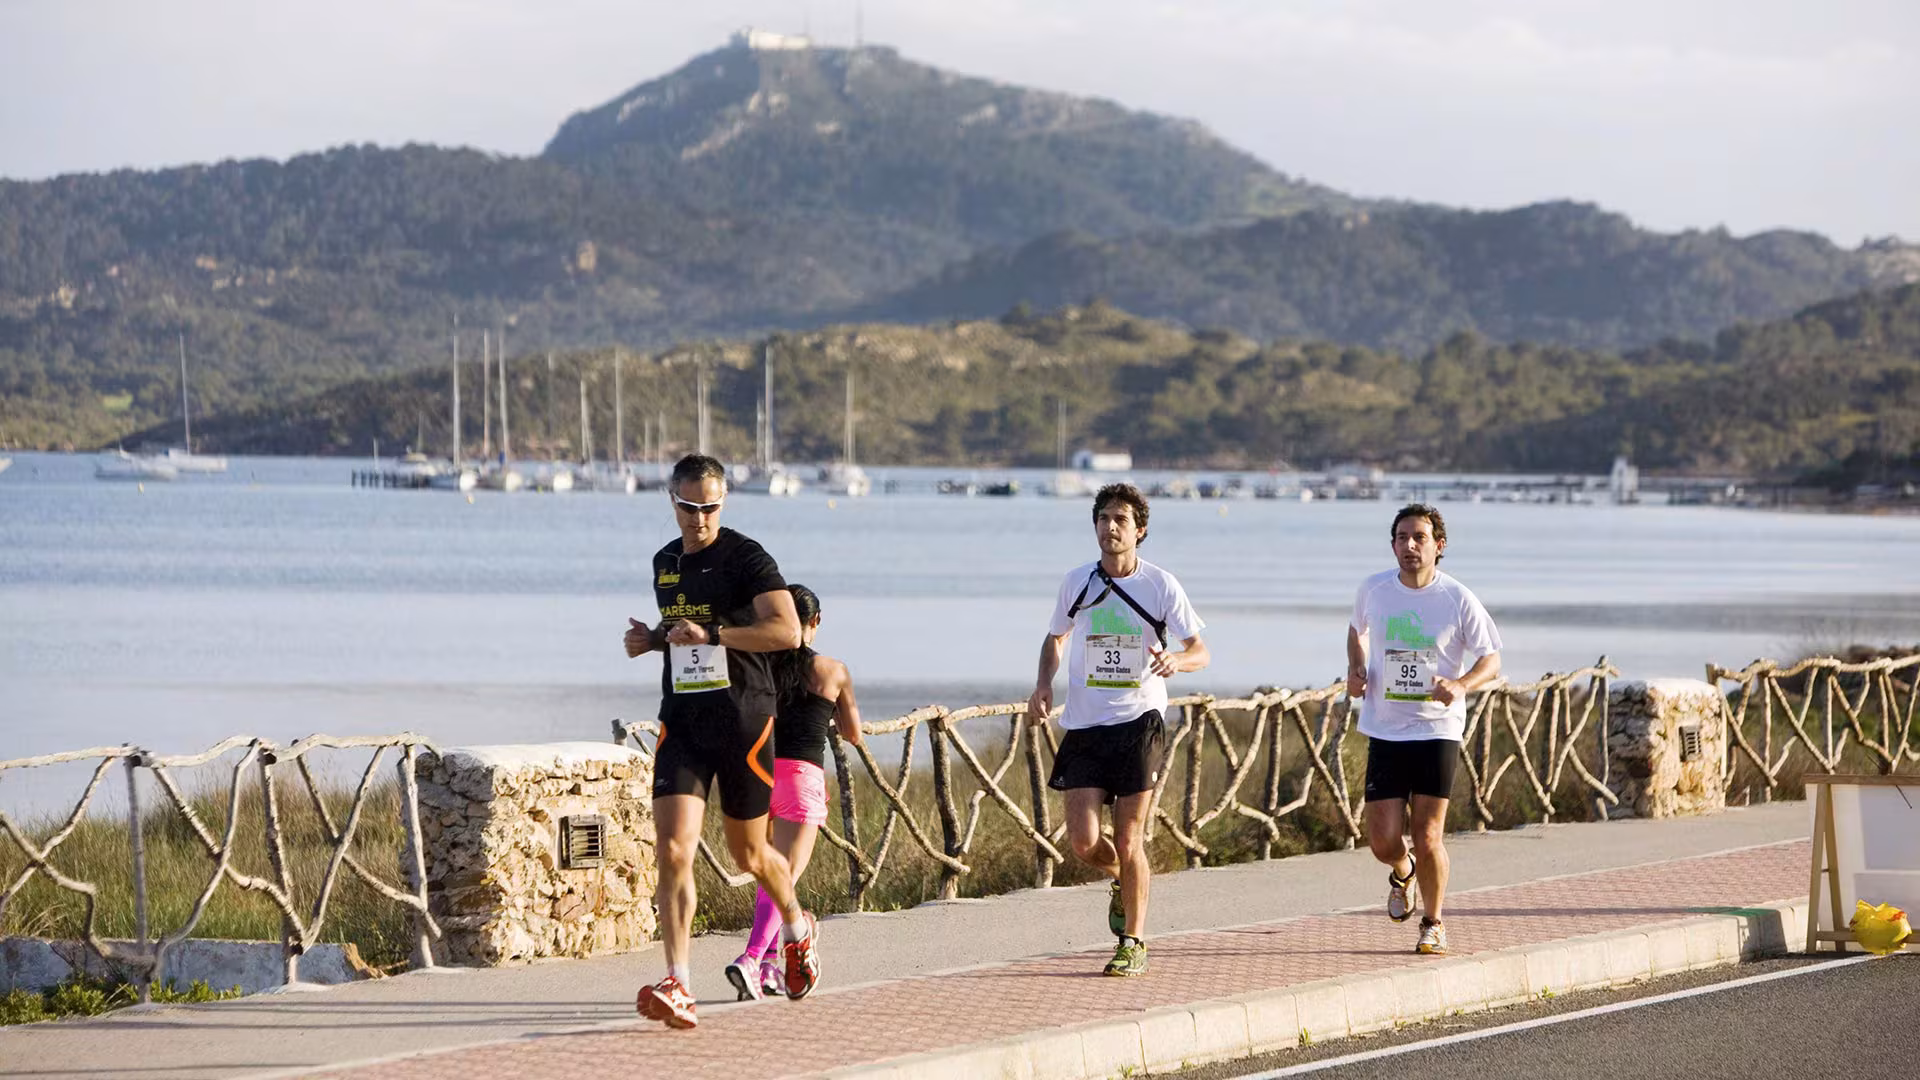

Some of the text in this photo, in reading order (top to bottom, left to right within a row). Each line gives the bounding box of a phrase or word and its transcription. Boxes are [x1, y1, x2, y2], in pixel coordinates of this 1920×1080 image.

[691, 649, 700, 665] 5
[1104, 650, 1121, 664] 33
[1096, 665, 1115, 673] German
[1401, 664, 1417, 679] 95
[1395, 679, 1408, 688] Sergi
